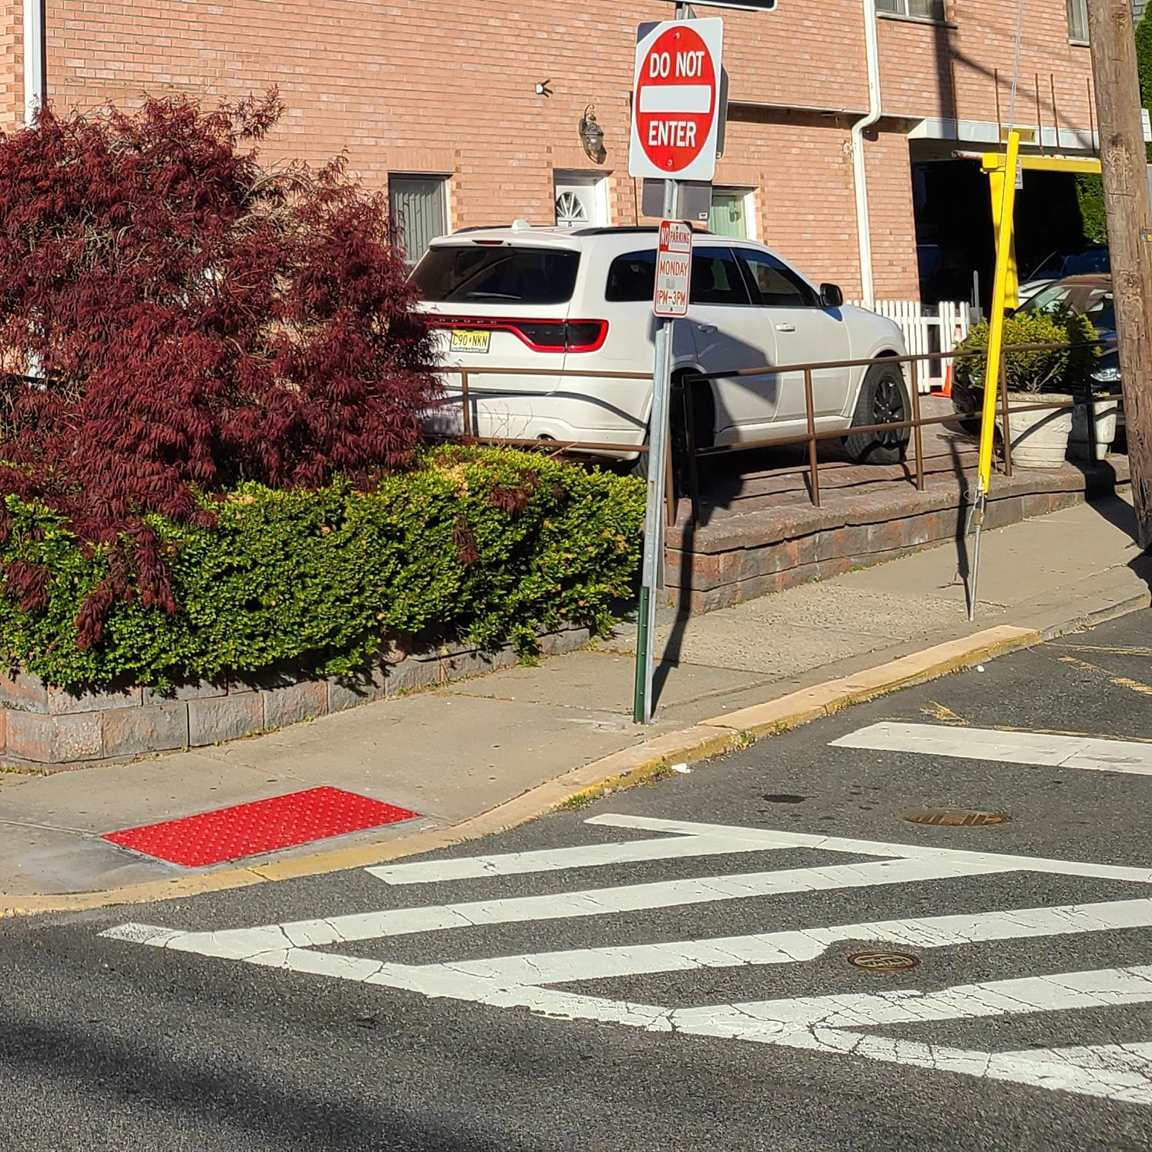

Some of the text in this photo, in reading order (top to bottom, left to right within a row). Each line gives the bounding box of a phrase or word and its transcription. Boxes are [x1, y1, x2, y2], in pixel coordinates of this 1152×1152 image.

[649, 50, 705, 78] DO NOT
[648, 120, 697, 147] ENTER
[670, 231, 690, 241] PARKING
[659, 261, 688, 277] MONDAY
